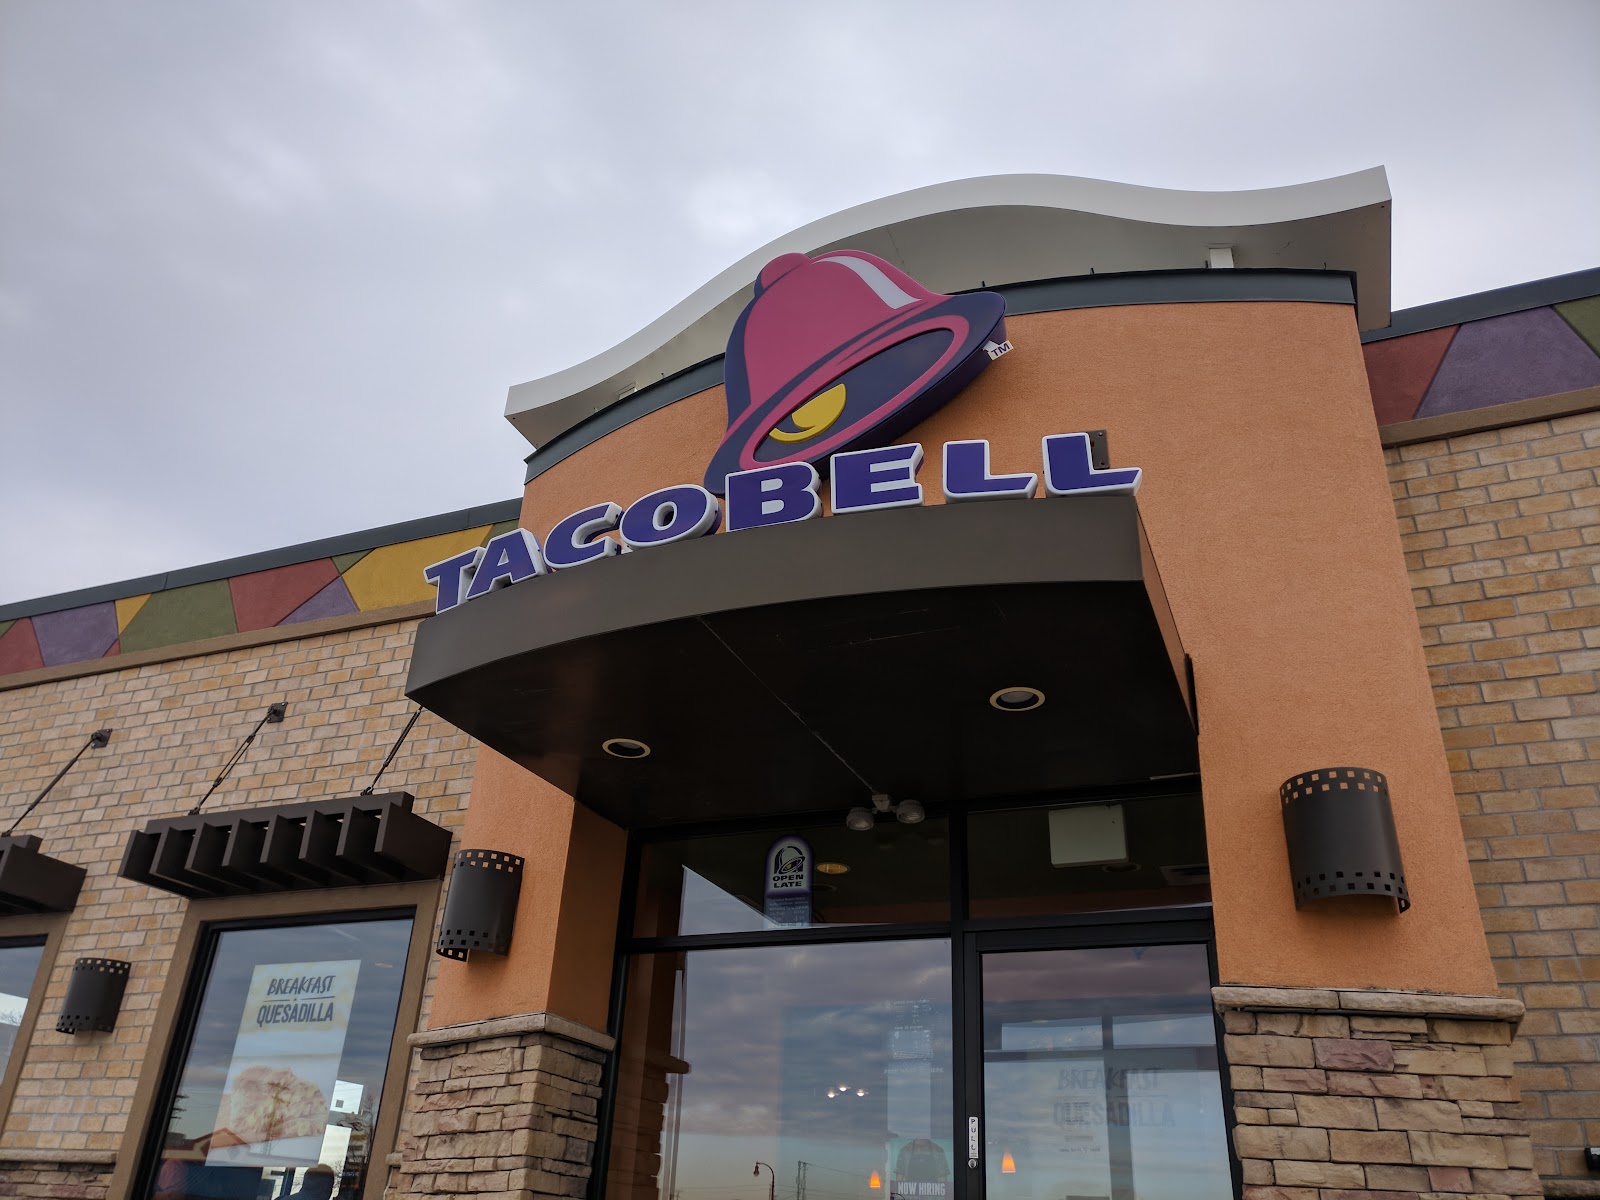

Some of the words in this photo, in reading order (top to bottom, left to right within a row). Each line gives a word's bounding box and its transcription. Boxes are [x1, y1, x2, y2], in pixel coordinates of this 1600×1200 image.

[990, 342, 1010, 357] TM
[423, 484, 721, 614] TACO
[725, 432, 1142, 533] BELL
[772, 874, 804, 882] OPEN
[773, 880, 802, 889] LATE
[266, 975, 337, 996] BREAKFAST
[256, 1002, 334, 1028] QUESADILLA
[897, 1181, 918, 1196] NOW
[918, 1181, 946, 1197] HIRING
